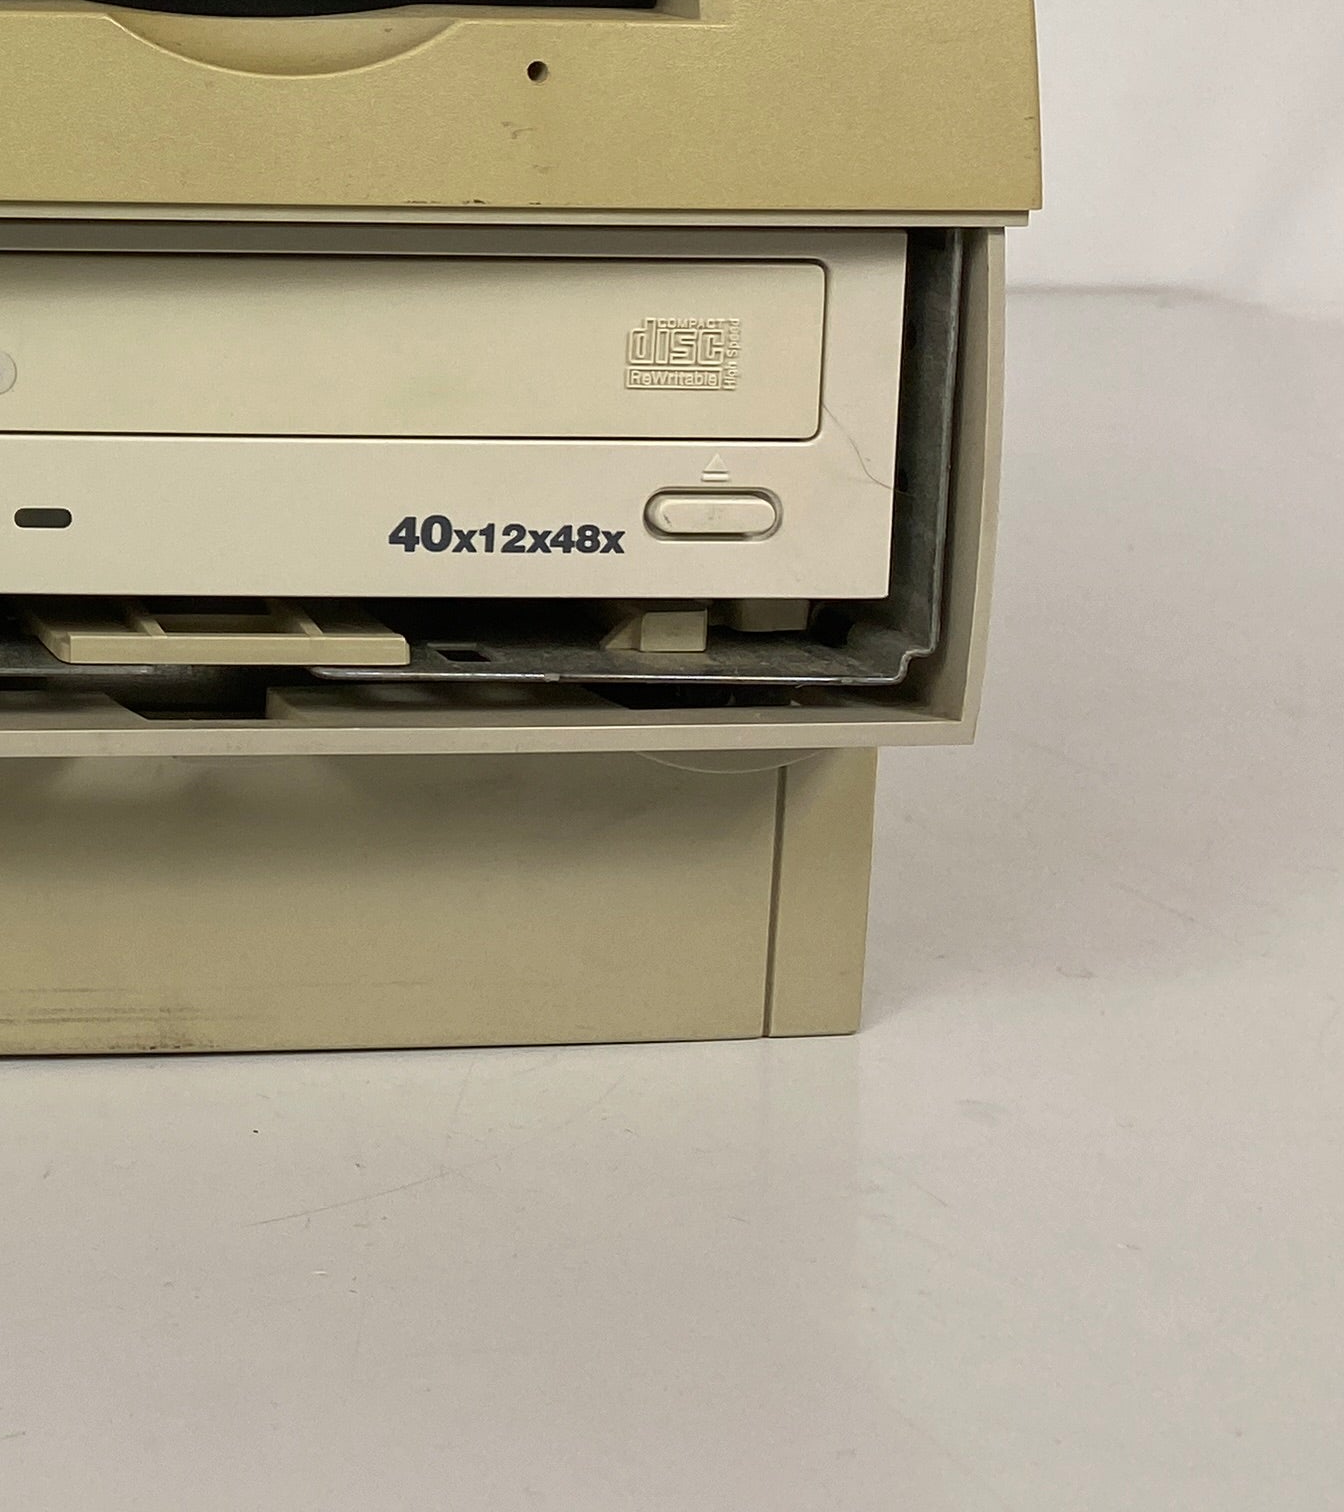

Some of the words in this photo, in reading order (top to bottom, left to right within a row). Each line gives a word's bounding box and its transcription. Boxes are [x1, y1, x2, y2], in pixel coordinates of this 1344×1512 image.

[656, 317, 725, 330] COMPACT
[630, 370, 718, 387] ReWritable
[388, 514, 626, 555] 40x12x48x
